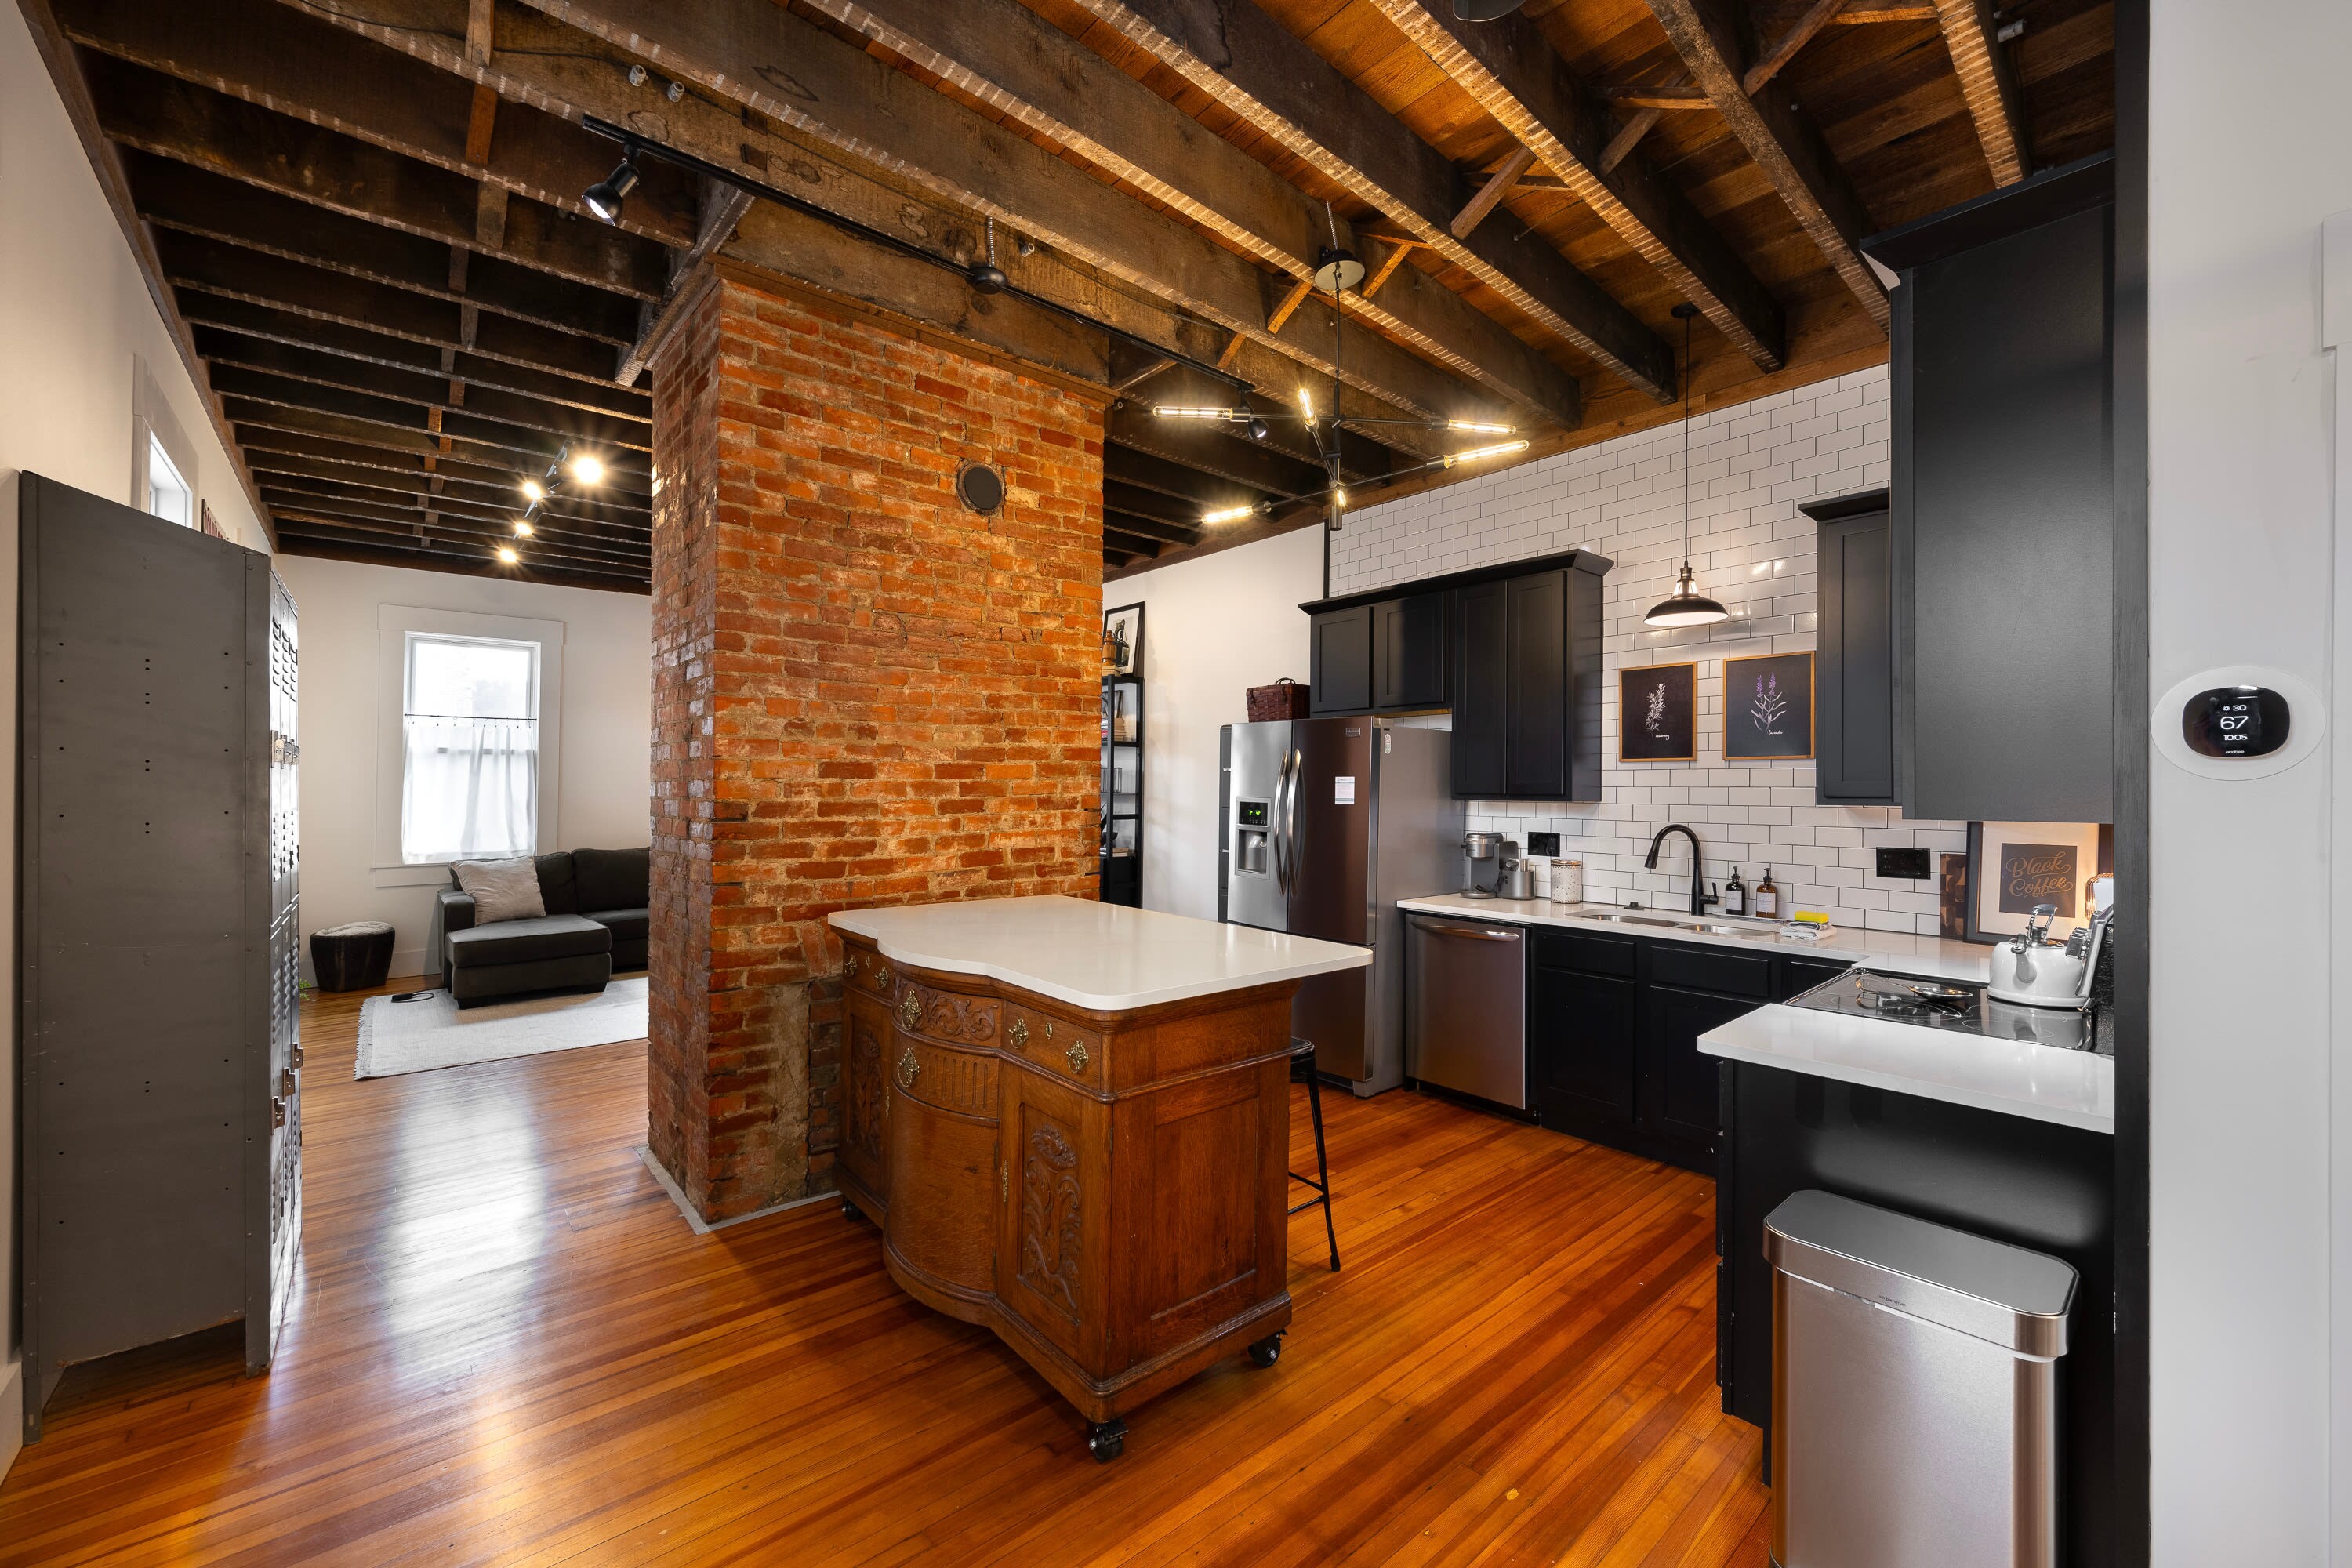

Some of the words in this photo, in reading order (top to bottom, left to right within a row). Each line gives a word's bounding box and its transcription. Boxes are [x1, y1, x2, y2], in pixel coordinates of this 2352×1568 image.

[2220, 716, 2249, 730] 67
[2005, 851, 2071, 878] Black
[2009, 877, 2074, 899] Coffee
